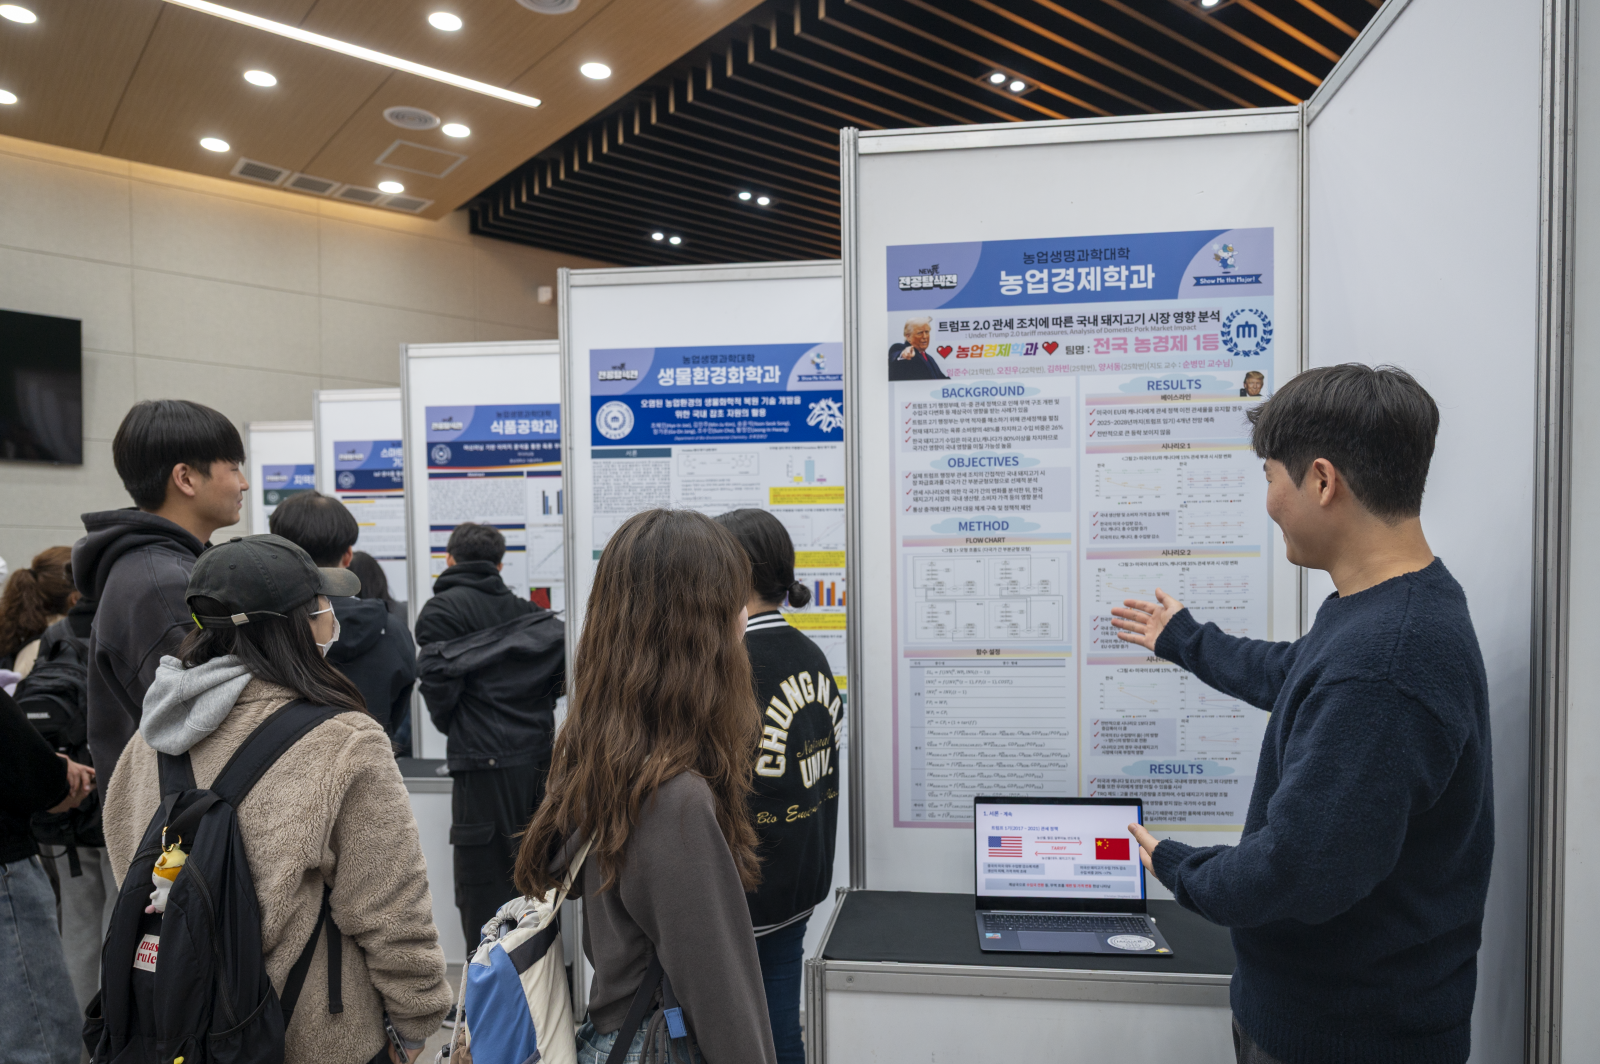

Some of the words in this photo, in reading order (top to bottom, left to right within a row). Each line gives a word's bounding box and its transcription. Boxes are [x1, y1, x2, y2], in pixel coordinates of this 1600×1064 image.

[1022, 247, 1131, 265] 농업생명과학대학
[898, 274, 958, 291] 전공탐색전
[999, 264, 1156, 296] 농업경제학과
[1236, 276, 1256, 284] Major!
[937, 320, 970, 333] 트럼프
[972, 320, 990, 331] 2.0
[992, 318, 1014, 332] 관세
[1016, 316, 1050, 330] 조치에
[1052, 315, 1074, 329] 따른
[1075, 314, 1099, 328] 국내
[1100, 312, 1145, 327] 돼지고기
[1147, 311, 1171, 325] 시장
[1172, 310, 1196, 324] 영향
[1197, 309, 1221, 323] 분석
[1069, 327, 1095, 336] Analysis
[1104, 326, 1133, 334] Domestic
[1174, 324, 1197, 332] Impact
[956, 342, 1039, 359] 농업경제학과
[1065, 345, 1085, 356] 팀명
[1093, 335, 1129, 355] 전국
[1134, 334, 1188, 354] 농경제
[1193, 333, 1220, 352] 1등
[682, 354, 755, 365] 농업생명과학대학
[1164, 361, 1177, 369] 교수
[1207, 358, 1234, 369] 교수님)
[657, 365, 781, 387] 생물환경화학과
[1147, 379, 1202, 391] RESULTS
[941, 385, 1025, 398] BACKGROUND
[1160, 393, 1192, 401] 베이스라인
[490, 419, 558, 435] 식품공학과
[947, 456, 1019, 468] OBJECTIVES
[958, 520, 1010, 532] METHOD
[1161, 549, 1186, 557] 시나리오
[1149, 763, 1204, 775] RESULTS
[756, 811, 778, 824] Bio
